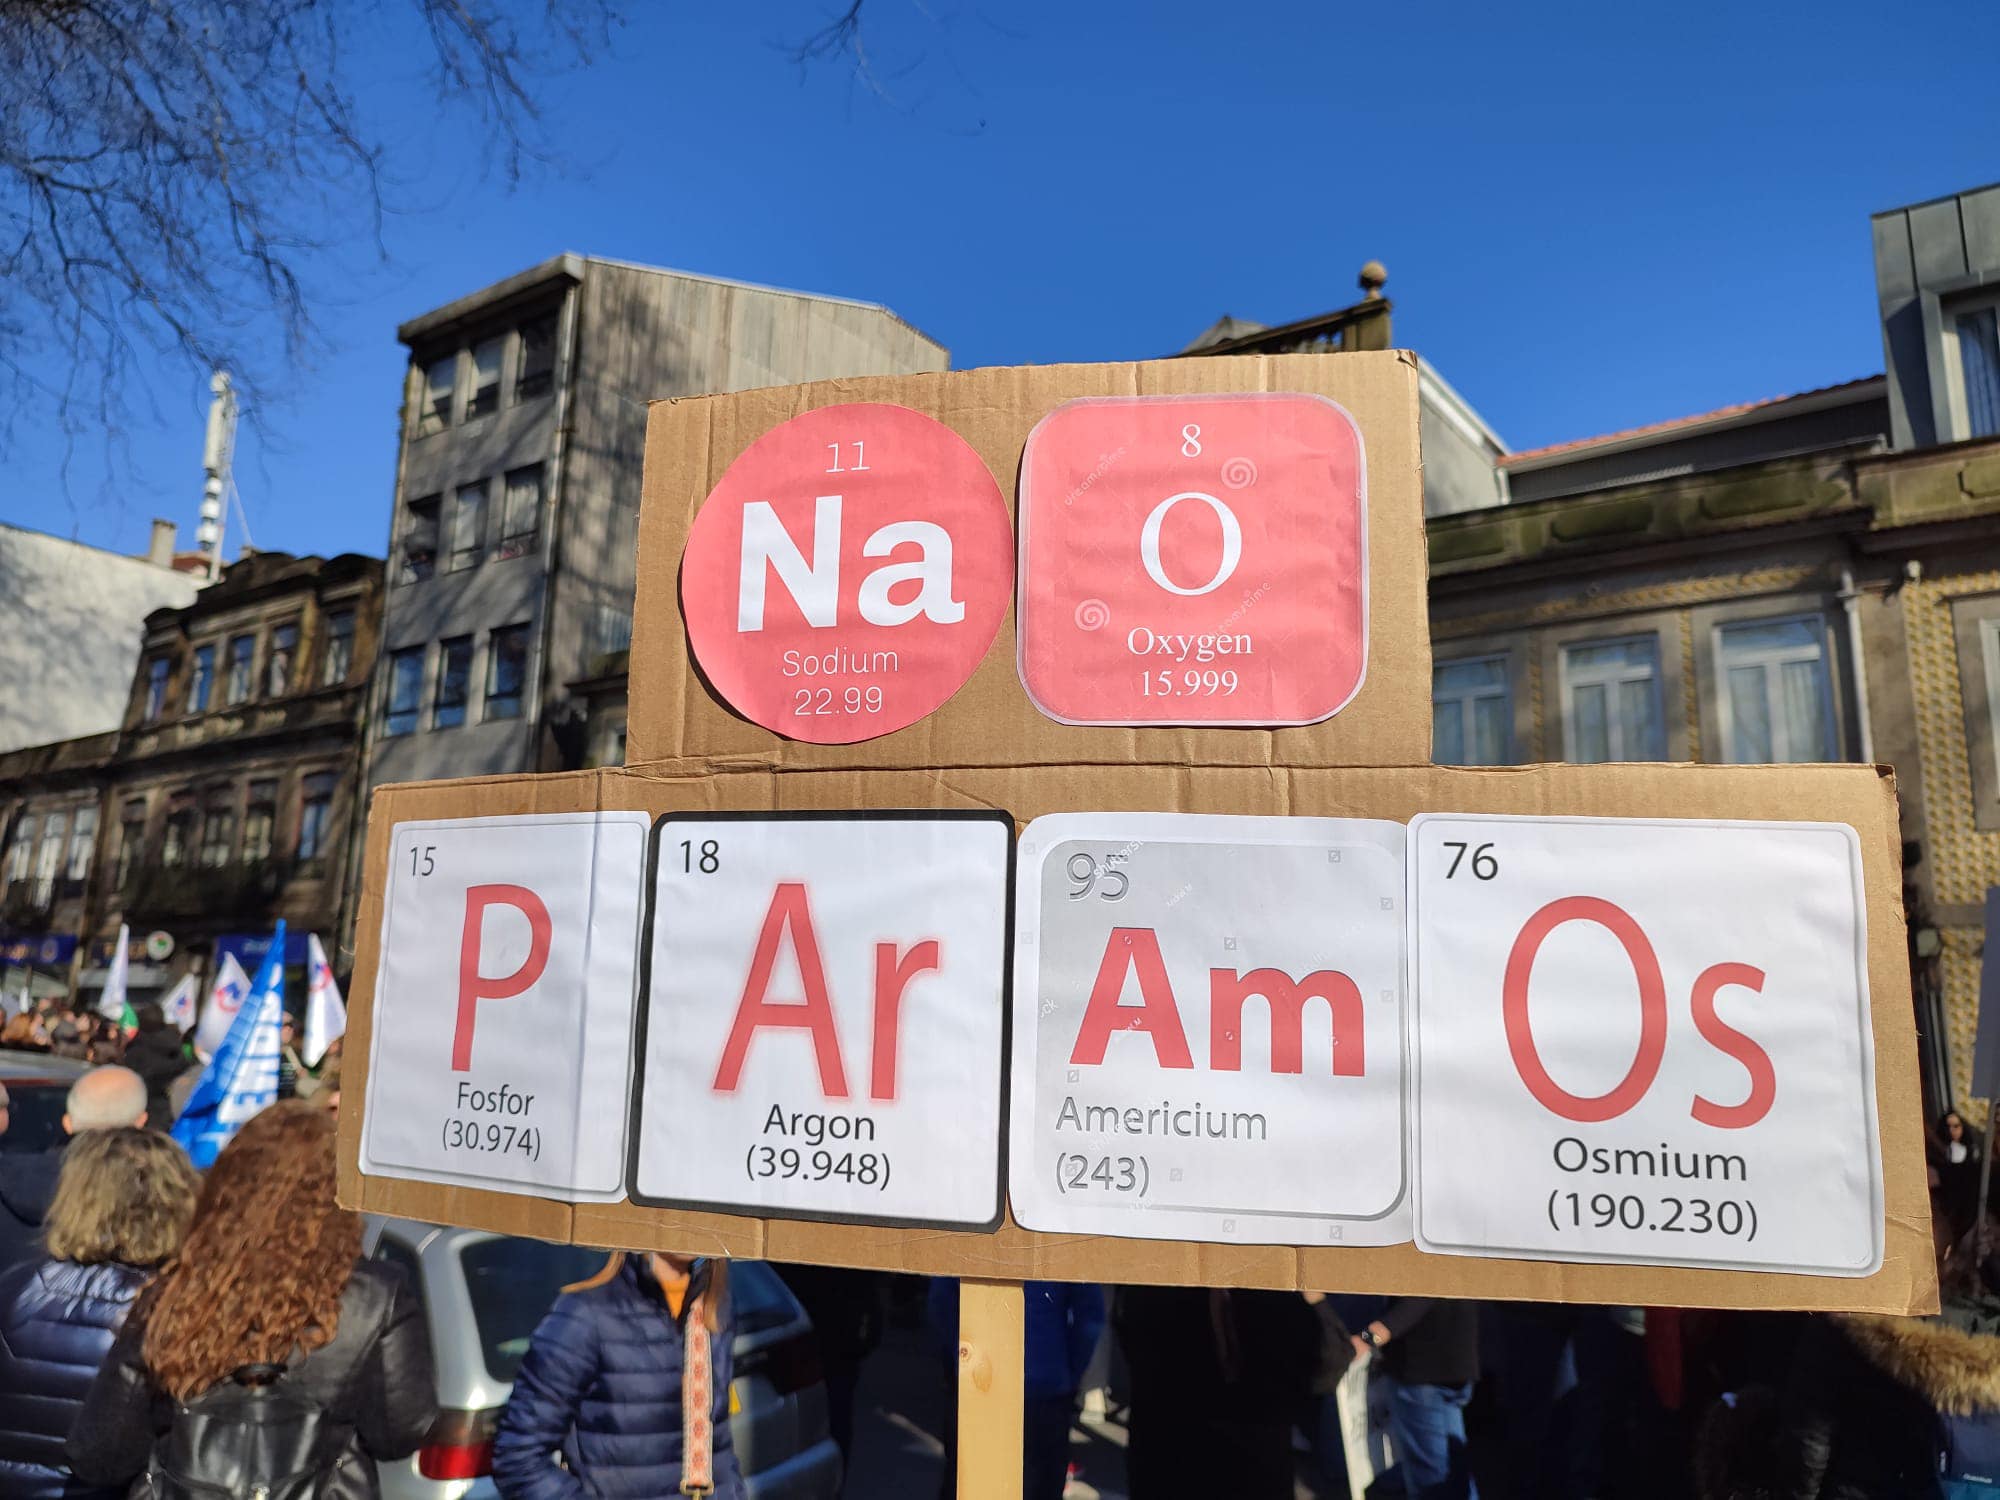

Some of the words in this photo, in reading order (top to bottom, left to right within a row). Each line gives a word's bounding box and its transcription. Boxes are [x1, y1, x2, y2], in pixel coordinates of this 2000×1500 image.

[825, 440, 871, 473] 11
[1181, 423, 1202, 458] 8
[737, 494, 966, 633] Na
[1140, 491, 1242, 596] O
[782, 647, 899, 677] Sodium
[1127, 626, 1253, 662] Oxygen
[794, 686, 883, 716] 22.99
[1141, 669, 1239, 697] 15.999
[410, 846, 437, 877] 15
[680, 839, 720, 874] 18
[1066, 852, 1130, 902] 95
[1443, 841, 1499, 881] 76
[452, 884, 552, 1072] P
[712, 882, 940, 1101] Ar
[1069, 926, 1366, 1077] Am
[1502, 896, 1777, 1129] Os
[456, 1081, 535, 1116] Fosfor
[1055, 1096, 1268, 1140] Americium
[442, 1119, 541, 1162] (30.974)
[763, 1103, 875, 1146] Argon
[746, 1144, 891, 1191] (39.948)
[1056, 1151, 1150, 1198] (243)
[1553, 1137, 1747, 1181] Osmium
[1547, 1189, 1759, 1242] (190.230)
